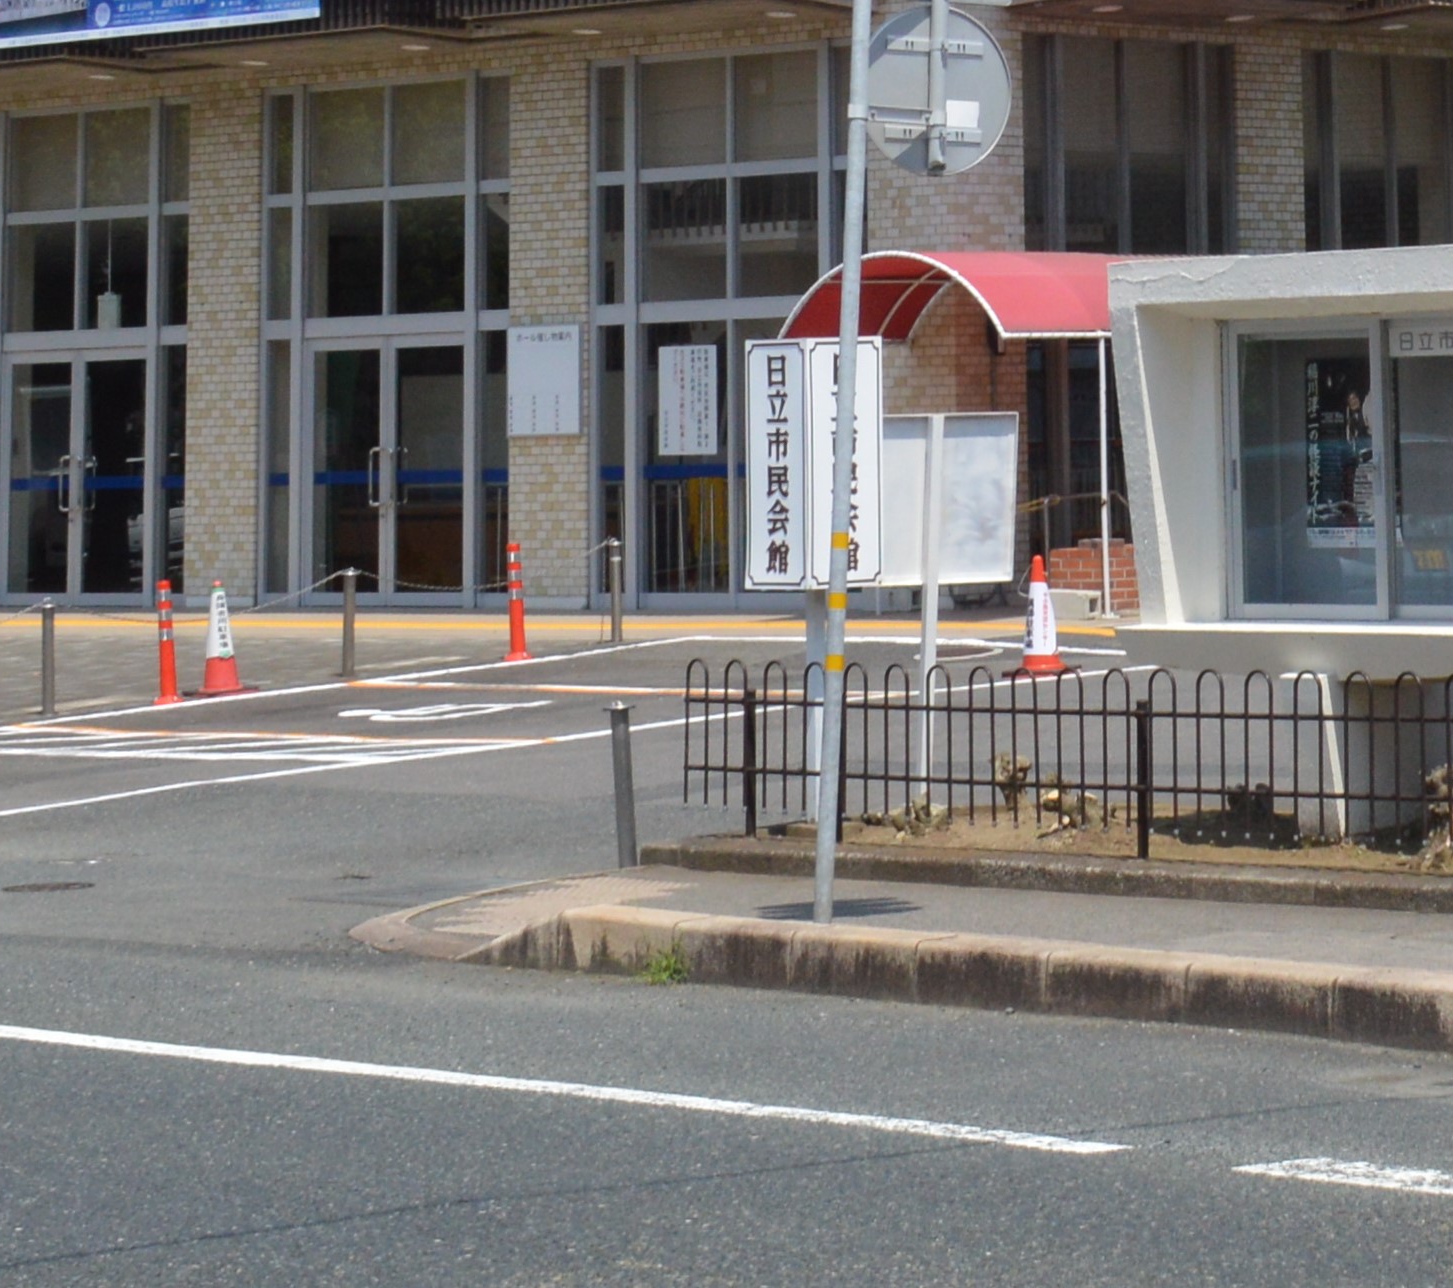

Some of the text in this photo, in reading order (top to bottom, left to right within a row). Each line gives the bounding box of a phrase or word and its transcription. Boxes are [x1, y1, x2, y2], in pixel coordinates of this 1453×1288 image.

[516, 331, 572, 343] ホール催し物案内
[765, 353, 790, 575] 日立市民会館
